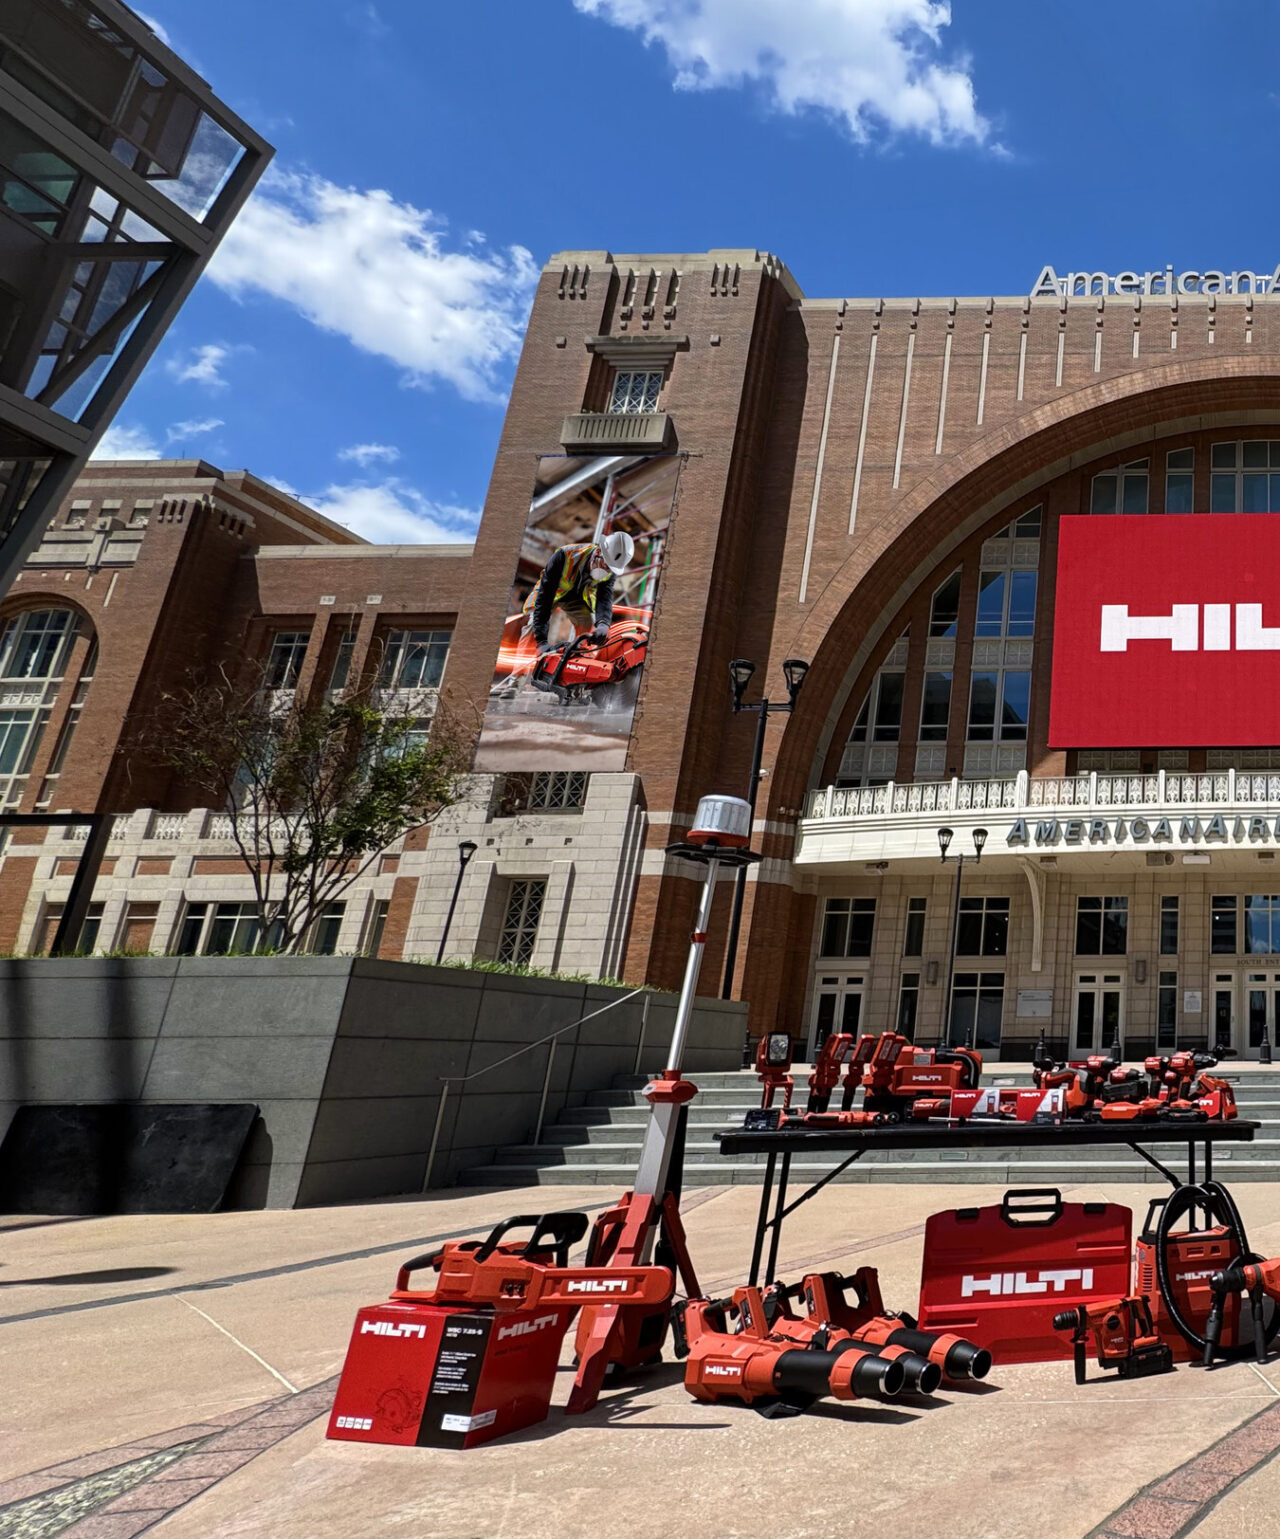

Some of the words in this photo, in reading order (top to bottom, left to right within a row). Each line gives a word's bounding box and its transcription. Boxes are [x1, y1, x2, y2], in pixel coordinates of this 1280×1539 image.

[1029, 264, 1257, 297] American
[566, 663, 587, 672] HILTI
[1006, 816, 1200, 842] AMERICAN
[567, 1280, 628, 1292] HILTI
[961, 1269, 1094, 1297] HILTI
[360, 1320, 427, 1339] HILTI
[498, 1313, 558, 1341] HILTI
[705, 1365, 741, 1376] HILTI
